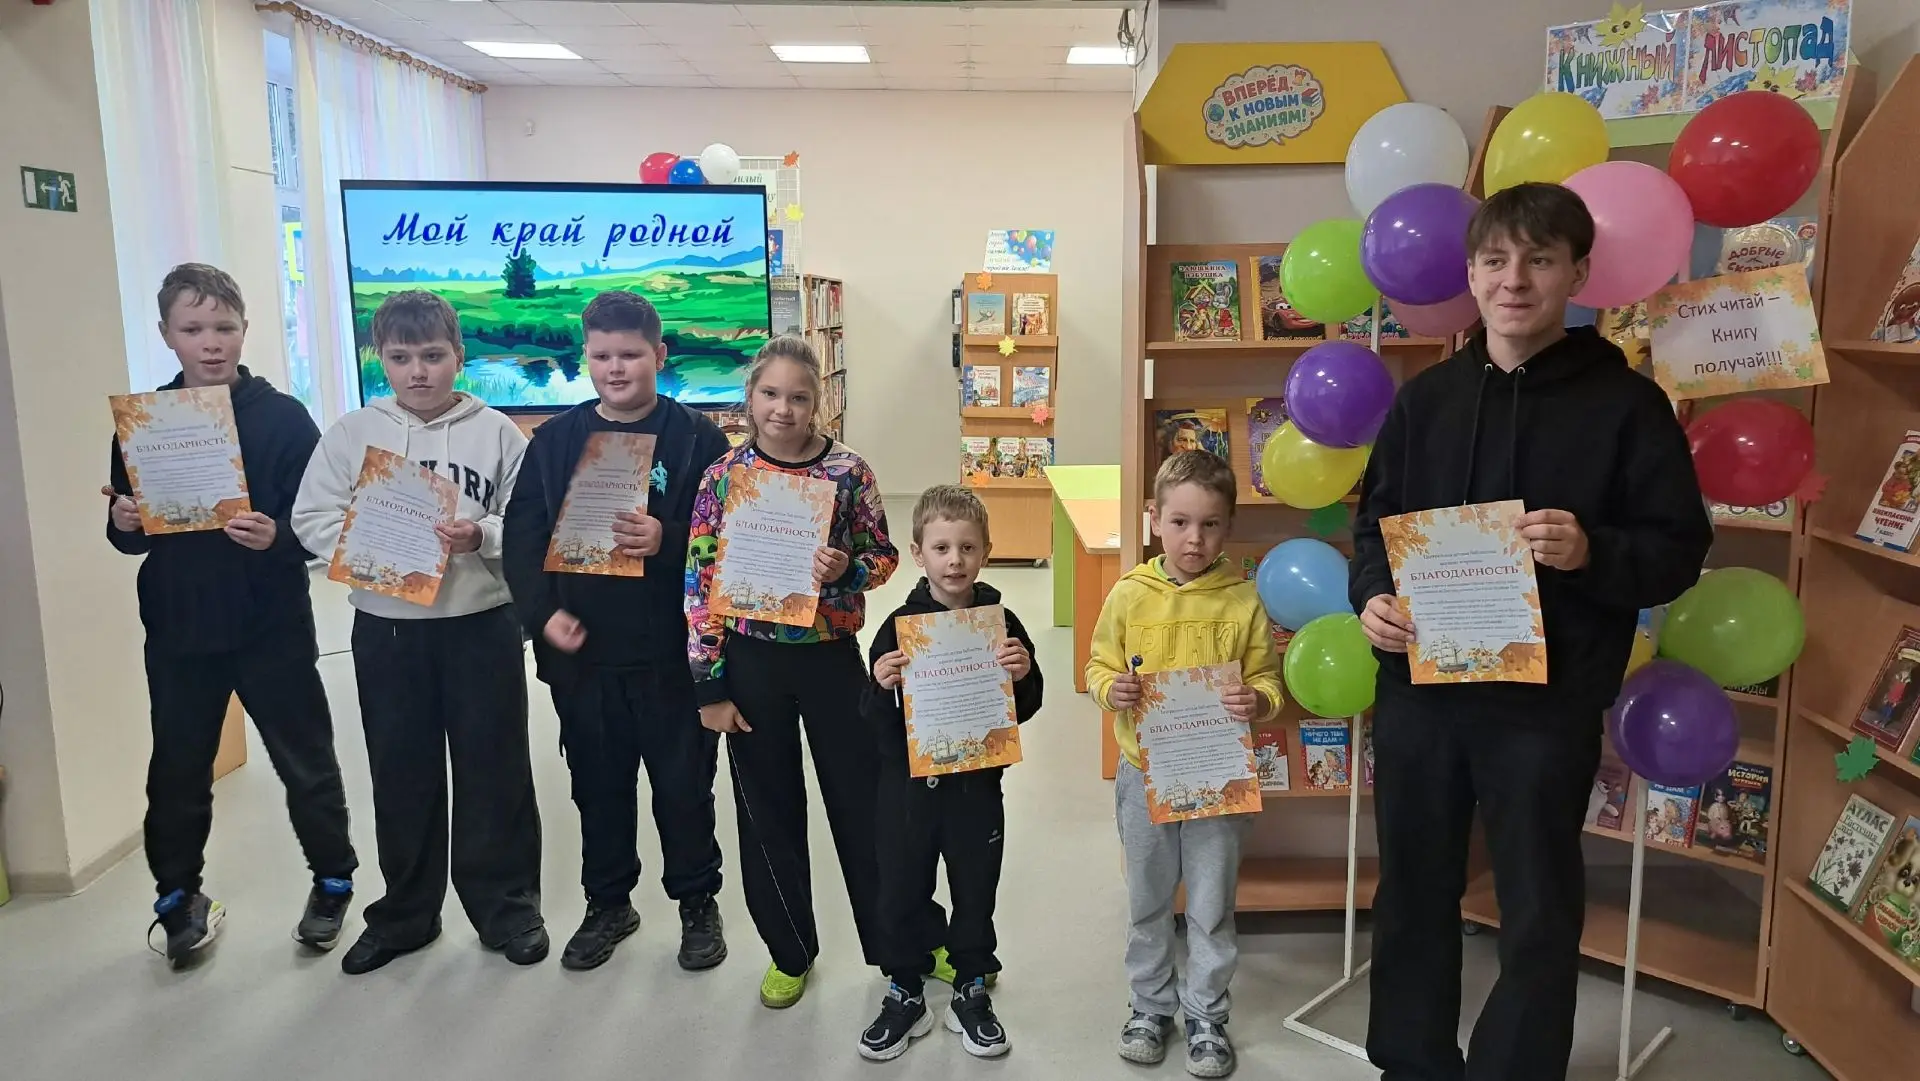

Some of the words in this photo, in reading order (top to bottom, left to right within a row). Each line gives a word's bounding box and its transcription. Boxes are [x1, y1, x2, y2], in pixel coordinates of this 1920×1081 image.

[1222, 75, 1294, 106] ВПЕРЁД,
[1229, 107, 1240, 121] К
[1243, 94, 1299, 116] НОВЫМ
[1225, 108, 1307, 140] ЗНАНИЯМ!
[382, 212, 469, 245] Мой
[491, 214, 586, 257] край
[602, 214, 736, 260] родной
[1678, 303, 1717, 319] Стих
[1719, 293, 1765, 313] читай
[1711, 326, 1758, 344] Книгу
[1694, 350, 1783, 376] получай!!!
[135, 437, 226, 453] БЛАГОДАРНОСТЬ
[735, 519, 817, 539] БЛАГОДАРНОСТЬ
[1874, 517, 1905, 531] ЧТЕНИЕ
[1410, 565, 1519, 580] БЛАГОДАРНОСТЬ
[914, 660, 998, 679] БЛАГОДАРНОСТЬ
[1150, 716, 1237, 733] БЛАГОДАРНОСТЬ
[1728, 768, 1769, 783] История
[1846, 803, 1890, 833] АТЛАС
